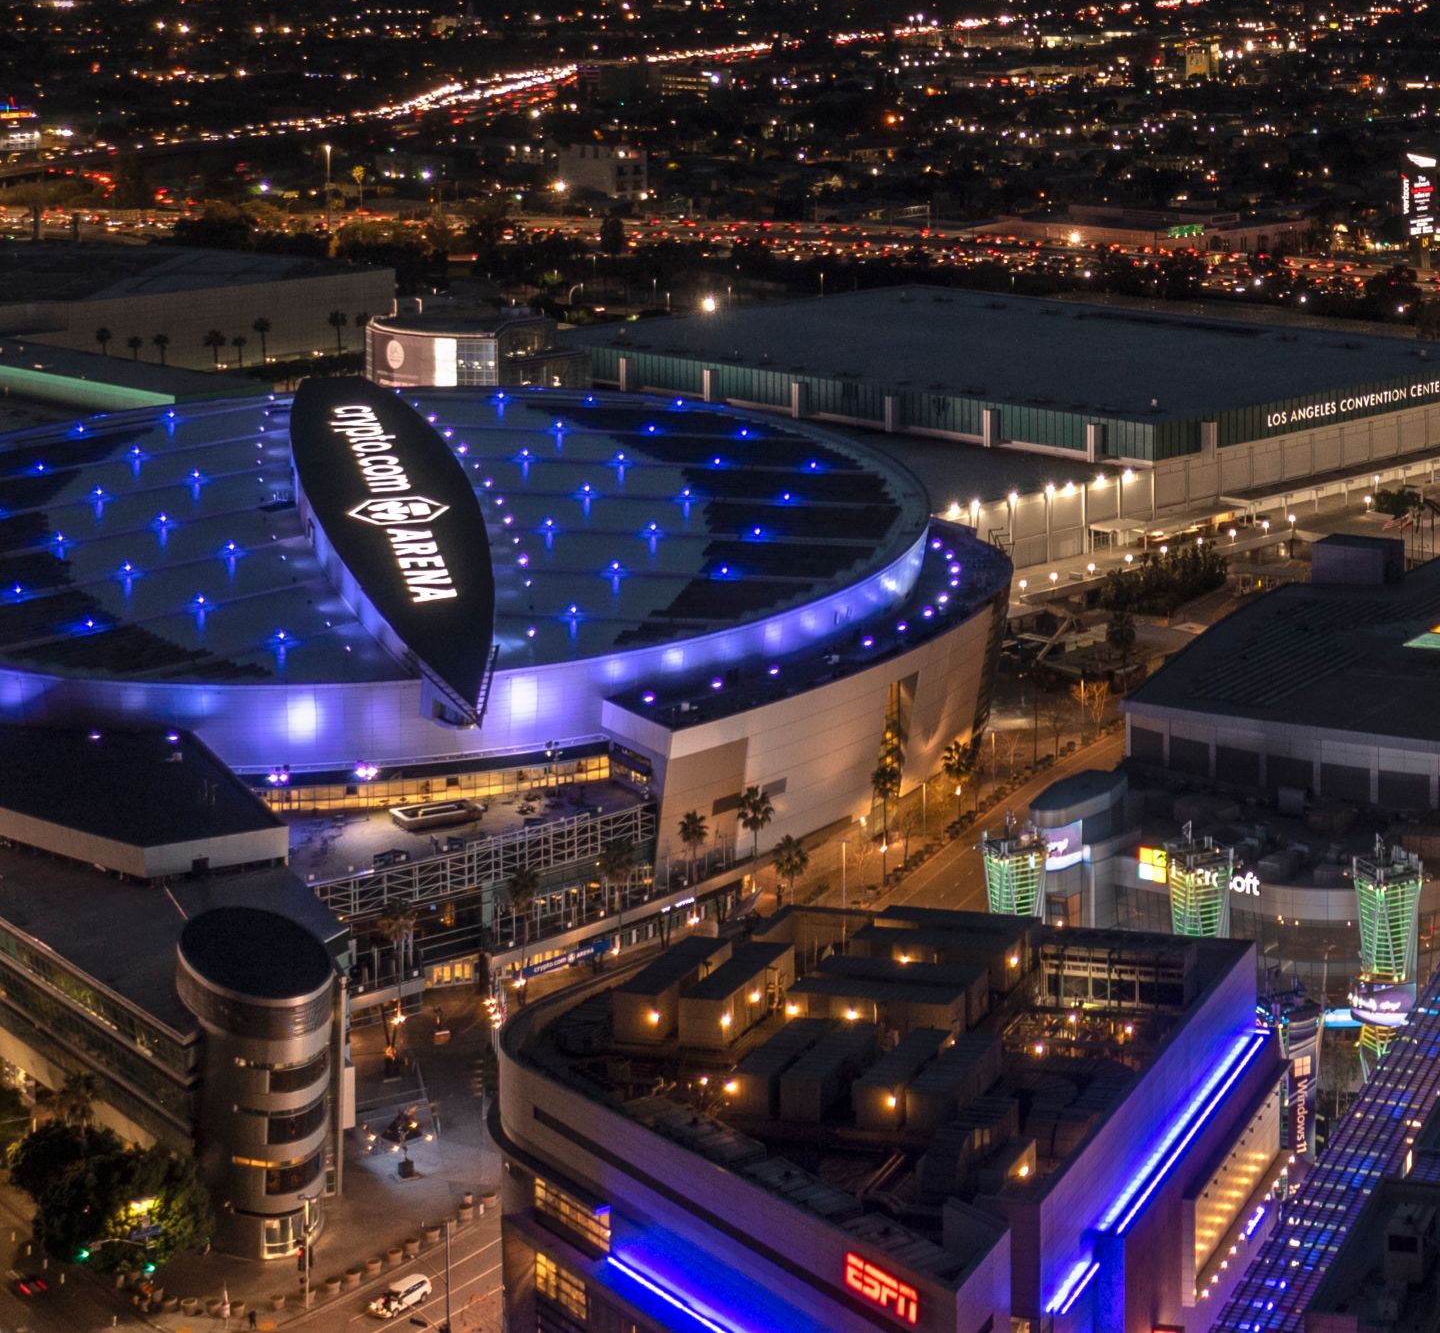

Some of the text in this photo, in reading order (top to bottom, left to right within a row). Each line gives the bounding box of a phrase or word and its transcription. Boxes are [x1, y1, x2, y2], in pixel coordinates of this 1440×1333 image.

[1402, 179, 1410, 215] verizon
[1267, 412, 1287, 427] LOS
[1290, 402, 1337, 422] ANGELES
[1340, 388, 1407, 413] CONVENTION
[330, 405, 412, 493] crypto.com
[386, 528, 458, 603] ARENA
[533, 957, 567, 974] crypto.com
[1296, 1079, 1309, 1154] Windows 11
[845, 1252, 918, 1325] ESPN
